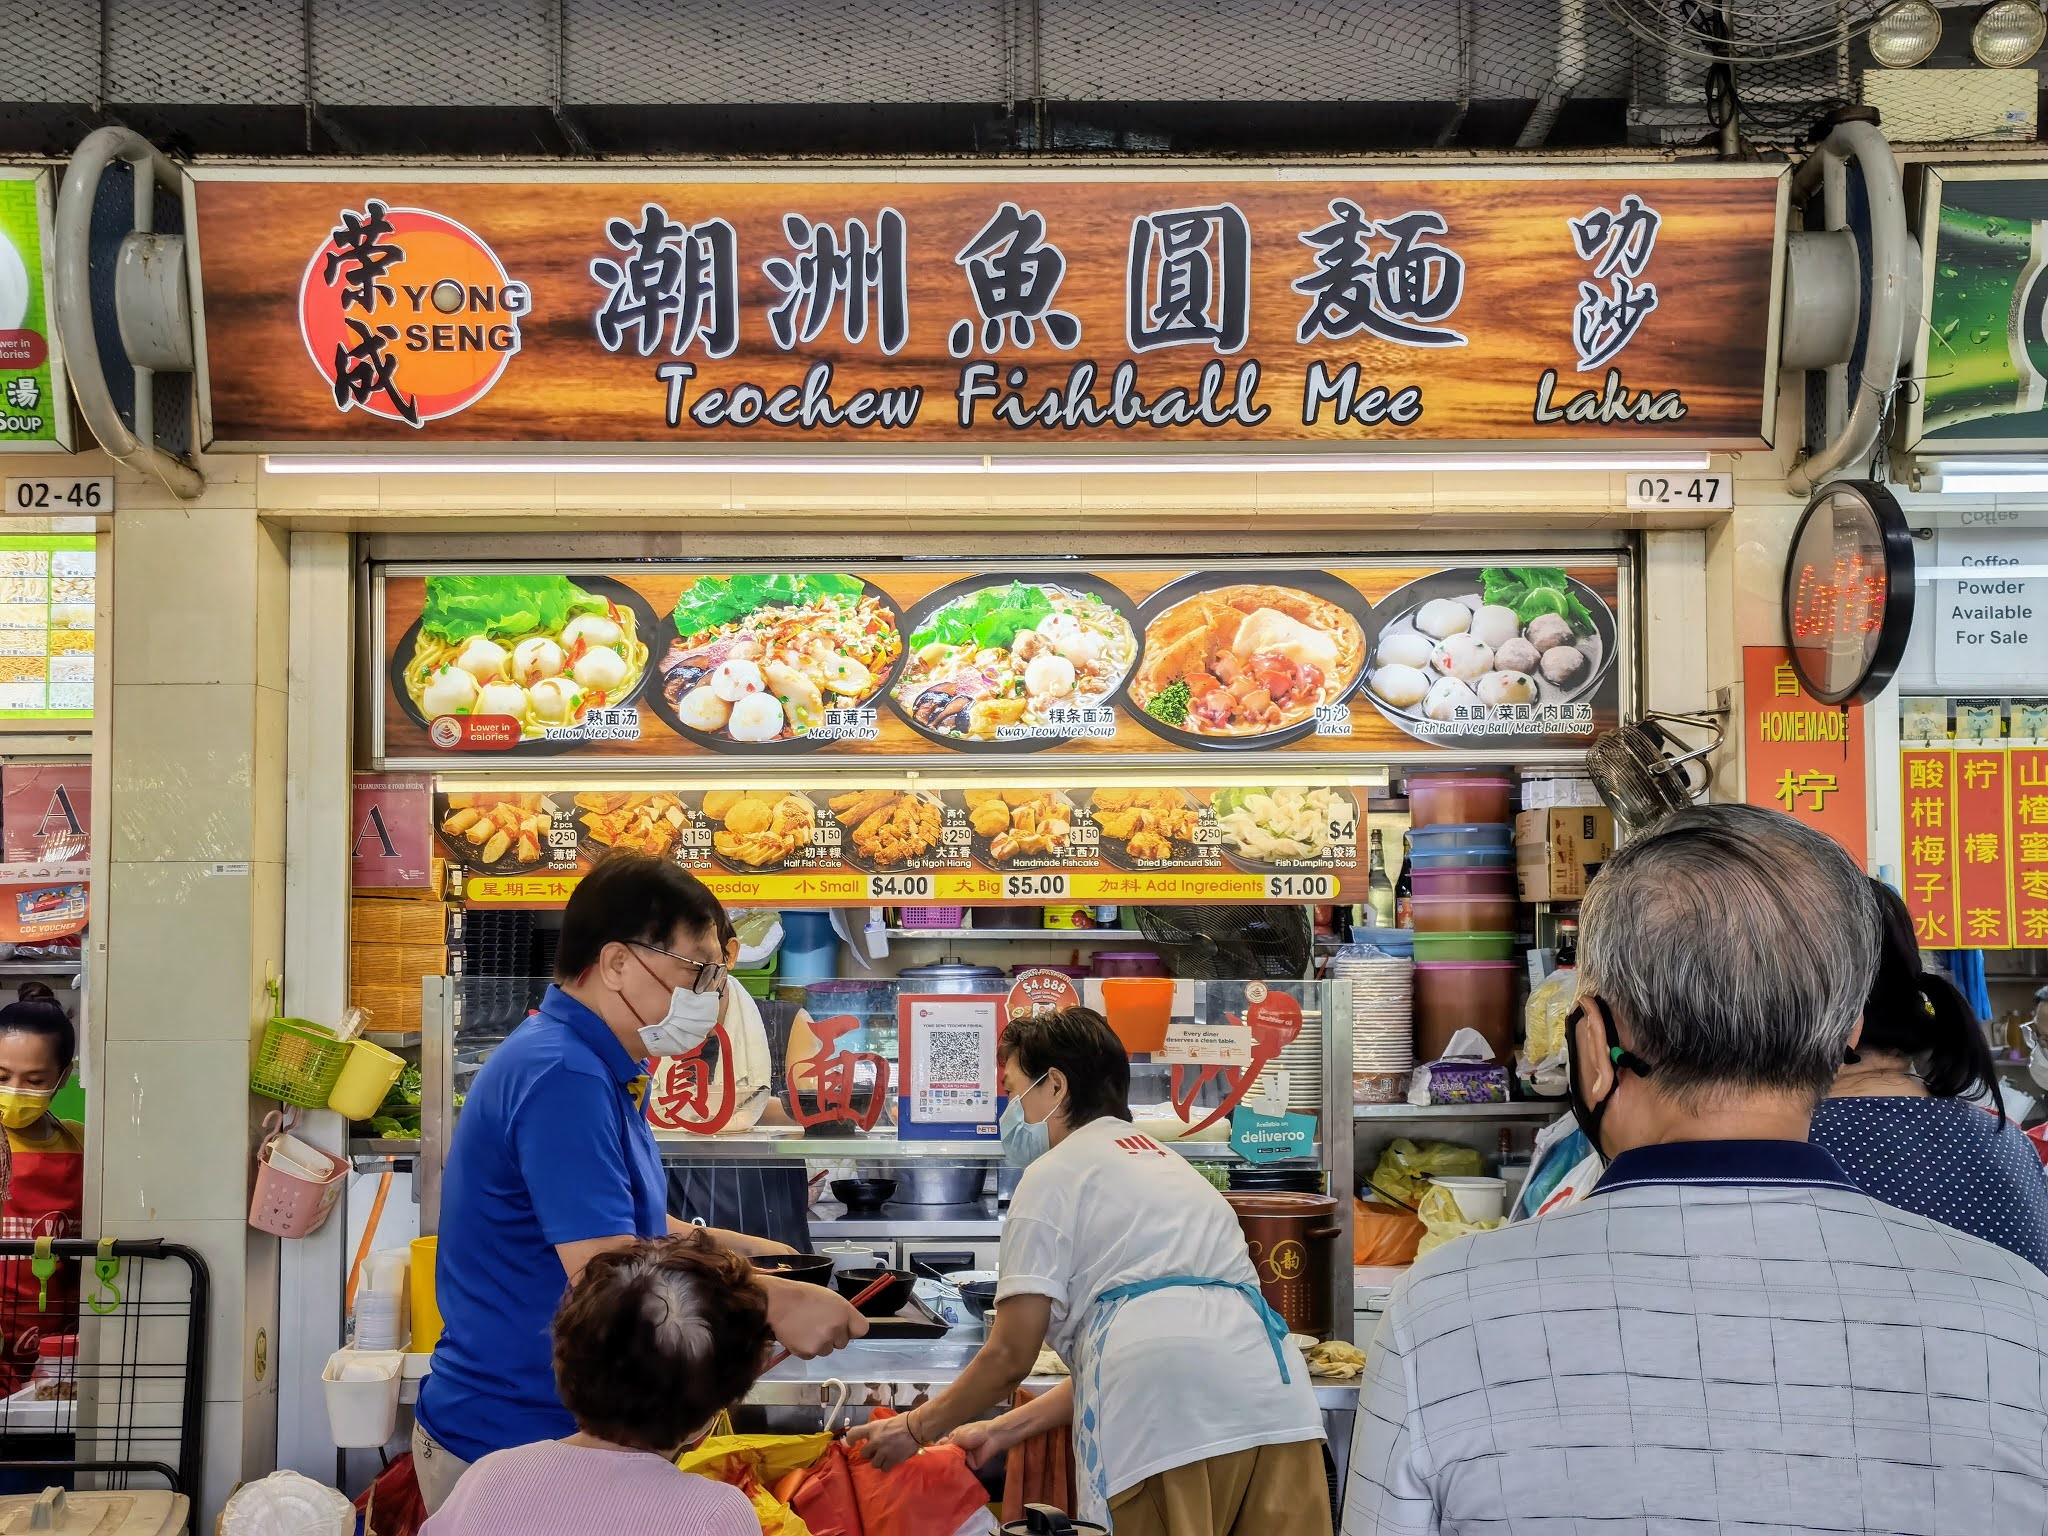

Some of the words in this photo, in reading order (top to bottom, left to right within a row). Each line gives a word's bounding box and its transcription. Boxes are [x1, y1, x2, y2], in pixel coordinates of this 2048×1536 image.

[591, 199, 1467, 358] 潮洲魚圓麵
[1573, 195, 1661, 372] 叻沙
[400, 279, 527, 314] YONG
[20, 339, 31, 348] in
[405, 324, 516, 351] SENG
[7, 379, 39, 408] 湯
[658, 361, 923, 428] Teochew
[958, 361, 1269, 428] Fishball
[1303, 361, 1424, 427] Mee
[1534, 367, 1687, 425] Laksa
[17, 483, 101, 508] 02-46
[1638, 479, 1721, 505] 02-47
[1961, 555, 2019, 567] Coffee
[1958, 580, 2025, 595] Powder
[1952, 605, 2032, 619] Available
[1956, 631, 1985, 645] For
[1990, 630, 2028, 645] Sale
[587, 709, 638, 726] 熟面汤
[826, 709, 876, 726] 面薄干
[1049, 708, 1113, 724] 粿条面汤
[1316, 705, 1349, 722] 叻沙
[470, 723, 499, 732] Lower
[501, 723, 510, 732] in
[996, 726, 1028, 738] Kway
[1030, 726, 1060, 737] Teow
[1061, 726, 1085, 736] Mee
[1087, 726, 1115, 737] Soup
[1317, 724, 1351, 734] Laksa
[1415, 723, 1436, 734] Fish
[1545, 723, 1565, 733] Ball
[1567, 722, 1593, 734] Soup
[1760, 711, 1850, 742] HOMEMADE
[470, 732, 510, 741] calories
[545, 728, 582, 739] Yellow
[585, 728, 608, 738] Mee
[610, 728, 639, 740] Soup
[808, 728, 833, 738] Mee
[835, 728, 855, 738] Pok
[858, 728, 878, 739] Dry
[1775, 768, 1838, 813] 柠
[33, 783, 89, 838] A
[553, 811, 573, 821] 两个
[817, 810, 835, 819] 每个
[947, 810, 965, 819] 两个
[696, 821, 707, 829] pc
[826, 820, 835, 828] pc
[953, 819, 966, 827] pcs
[1083, 819, 1093, 827] pc
[1204, 819, 1218, 827] pcs
[352, 804, 402, 857] A
[1329, 820, 1354, 841] $4
[805, 847, 842, 859] 切半粿
[936, 847, 971, 858] 大五香
[1052, 846, 1099, 858] 手工西刀
[1198, 846, 1221, 858] 豆支
[1321, 846, 1357, 858] 鱼饺汤
[1909, 759, 1948, 940] 酸柑梅子水
[1964, 759, 2001, 938] 柠檬茶
[2018, 756, 2048, 939] 山楂蜜枣茶
[553, 849, 577, 861] 薄饼
[676, 848, 712, 860] 炸豆干
[548, 861, 578, 870] Popiah
[693, 861, 712, 869] Gan
[783, 859, 801, 868] Half
[801, 859, 817, 868] Fish
[819, 860, 841, 868] Cake
[907, 859, 920, 869] Big
[922, 859, 945, 869] Ngoh
[947, 859, 972, 869] Hiang
[1013, 859, 1060, 867] Handmade
[1062, 858, 1099, 867] Fishcake
[1137, 858, 1160, 867] Dried
[1161, 858, 1203, 867] Beancurd
[1205, 858, 1221, 867] Skin
[1275, 858, 1292, 867] Fish
[1293, 858, 1334, 869] Dumpling
[1335, 858, 1357, 869] Soup
[481, 882, 575, 897] 星期三休
[706, 881, 760, 896] nesday
[794, 879, 816, 894] 小
[820, 879, 859, 893] Small
[872, 876, 928, 897] $4.00
[953, 878, 975, 893] 大
[979, 879, 1001, 895] Big
[1008, 874, 1065, 897] $5.00
[1098, 878, 1141, 893] 加料
[1146, 878, 1178, 893] Add
[1181, 877, 1263, 896] Ingredients
[1270, 876, 1328, 897] $1.00
[20, 926, 37, 934] CDC
[39, 923, 76, 932] VOUCHER
[1241, 1130, 1305, 1144] deliveroo
